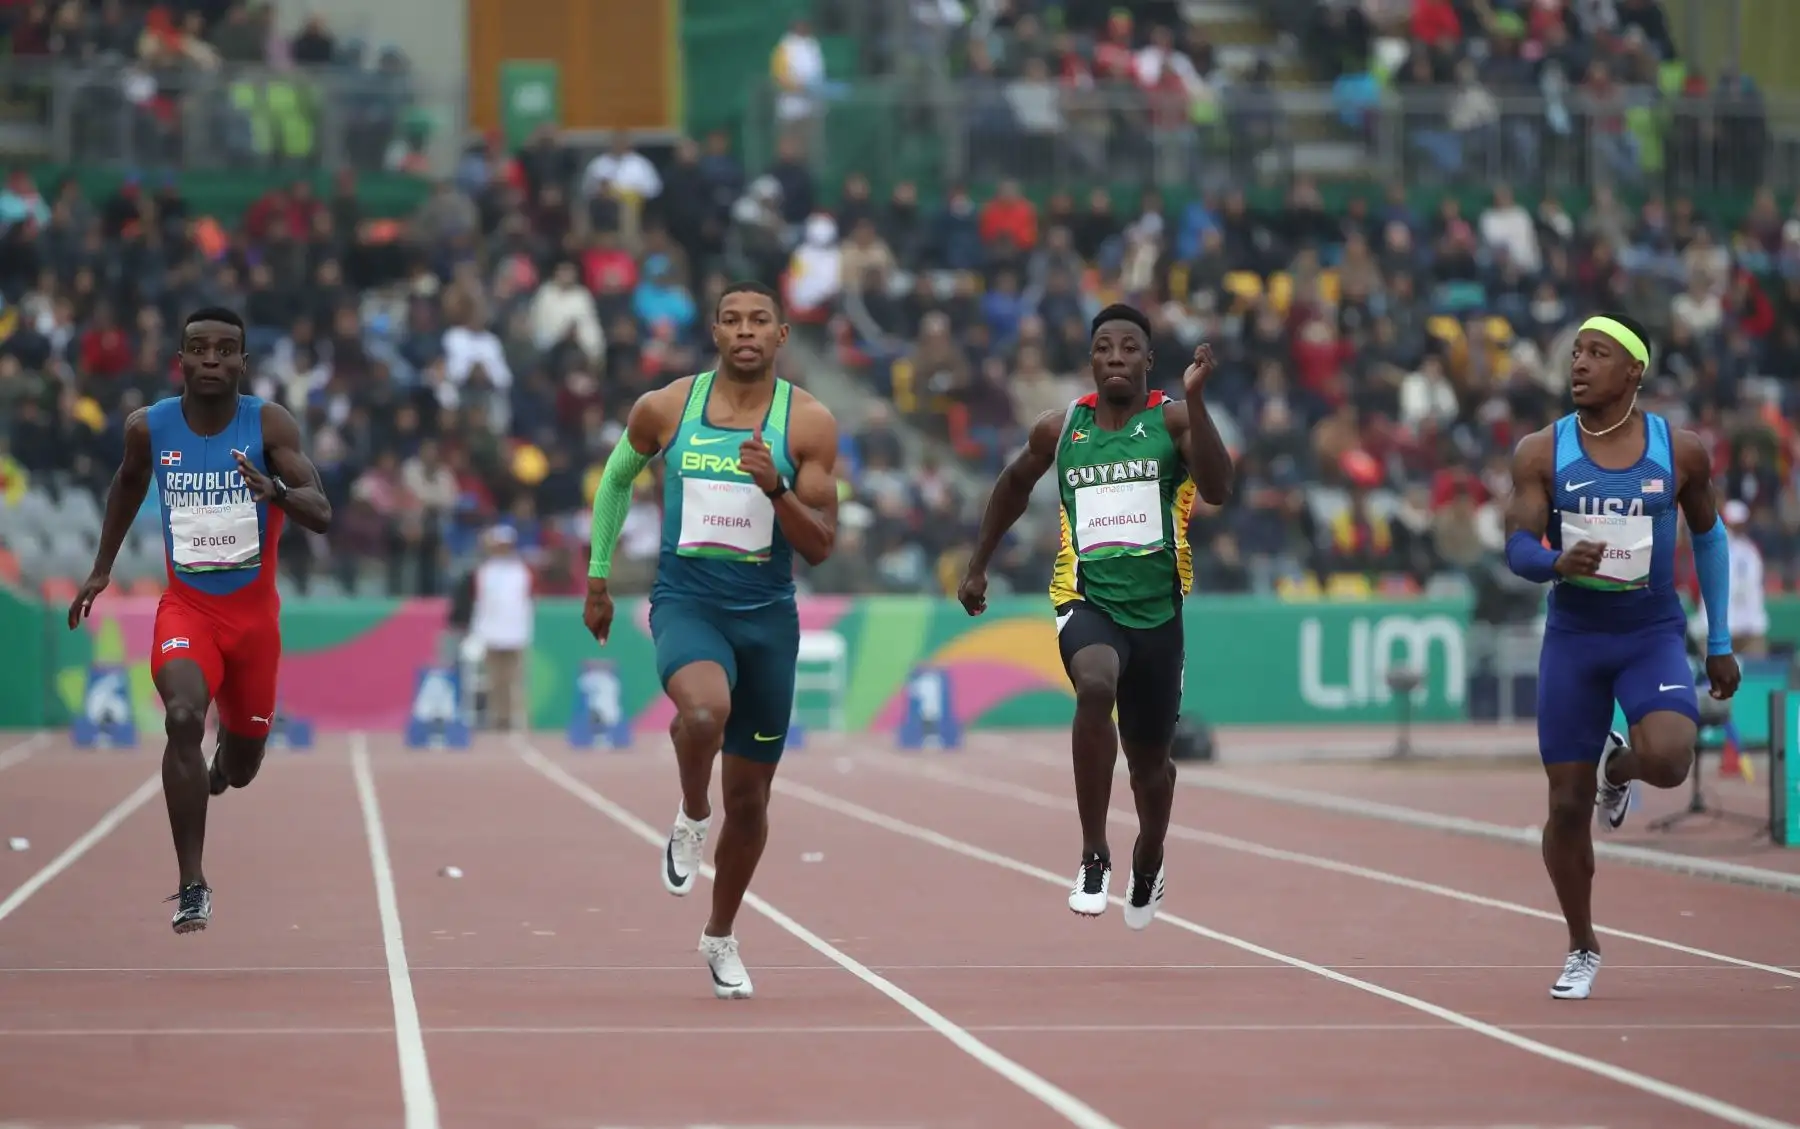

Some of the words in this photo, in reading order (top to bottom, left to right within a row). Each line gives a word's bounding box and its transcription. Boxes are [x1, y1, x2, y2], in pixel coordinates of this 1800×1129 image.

[166, 470, 248, 491] REPUBLICA
[1066, 459, 1160, 488] GUYANA
[164, 489, 252, 508] DOMINICANA
[1579, 496, 1643, 516] USA
[702, 515, 751, 528] PEREIRA
[1088, 513, 1147, 528] ARCHIBALD
[193, 537, 207, 547] DE
[209, 535, 236, 546] OLEO
